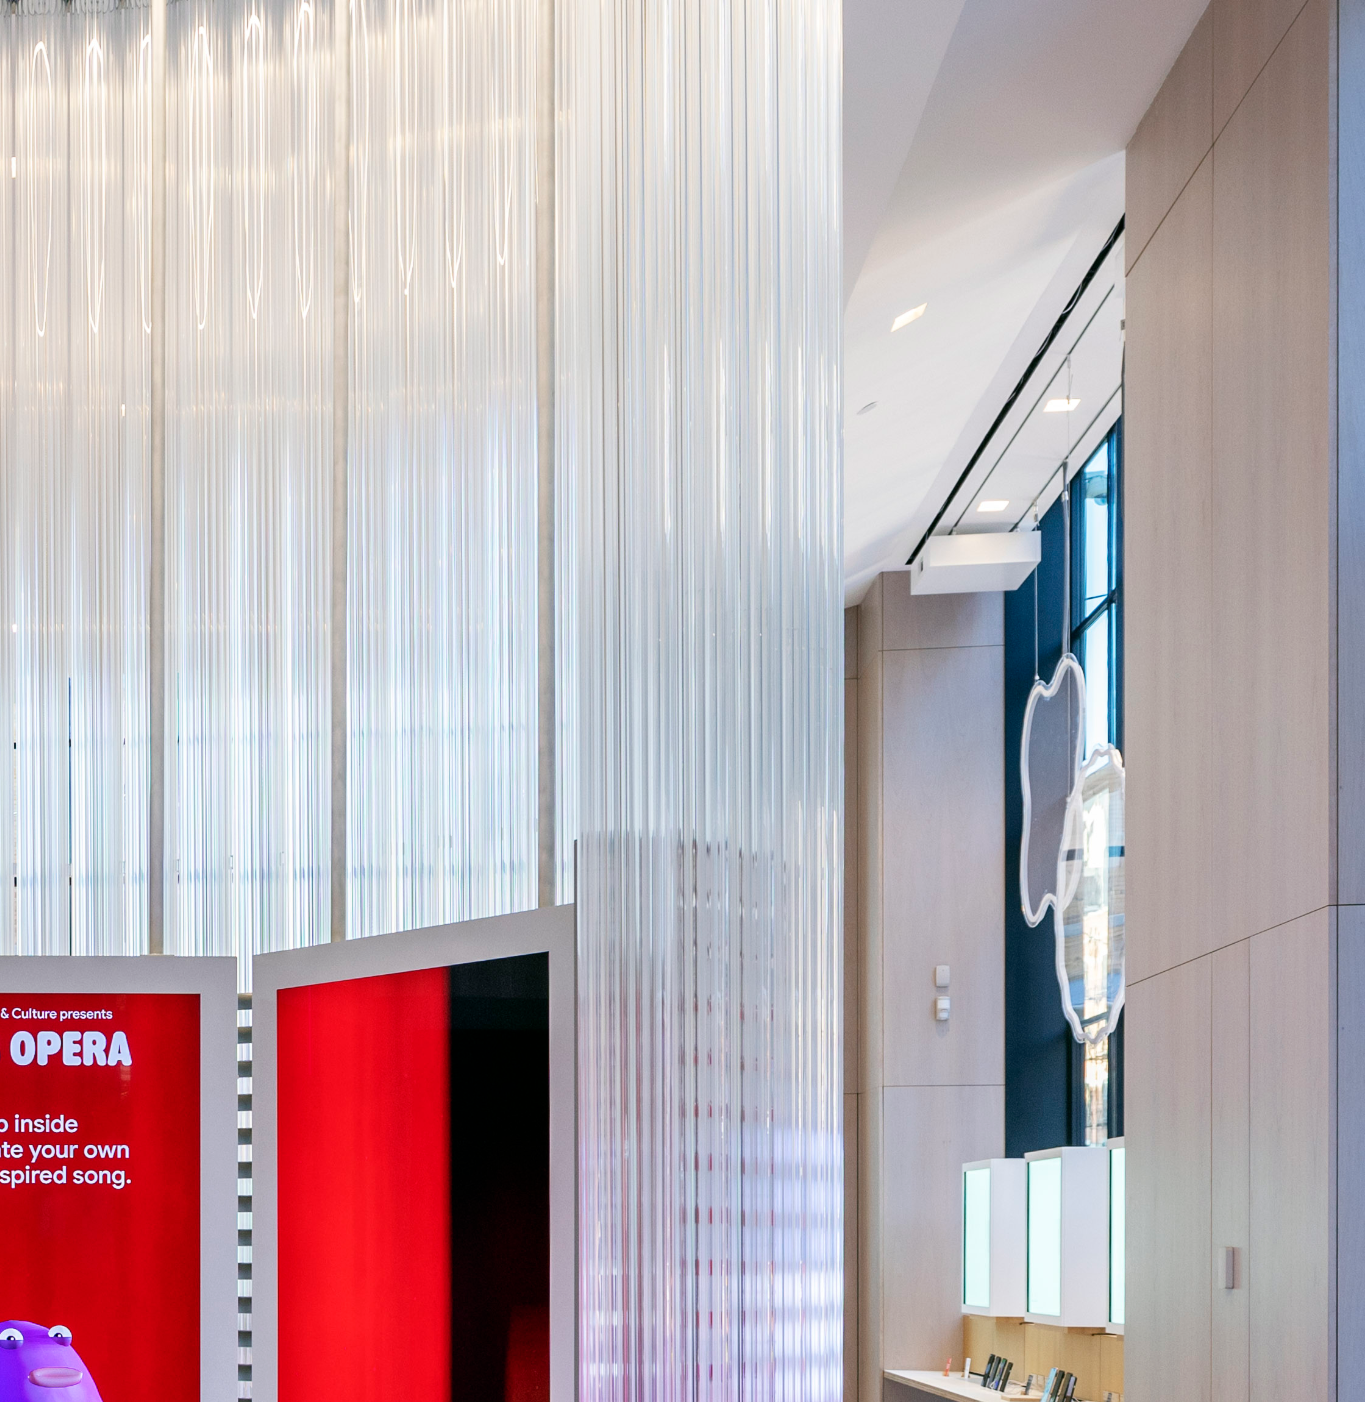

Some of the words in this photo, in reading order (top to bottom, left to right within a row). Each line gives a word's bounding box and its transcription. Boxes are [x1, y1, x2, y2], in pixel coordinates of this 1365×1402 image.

[0, 1008, 9, 1019] &
[11, 1008, 57, 1019] Culture
[59, 1009, 113, 1021] presents
[9, 1030, 132, 1066] OPERA
[14, 1113, 79, 1133] inside
[29, 1144, 79, 1163] your
[83, 1144, 130, 1159] own
[72, 1170, 132, 1190] song.
